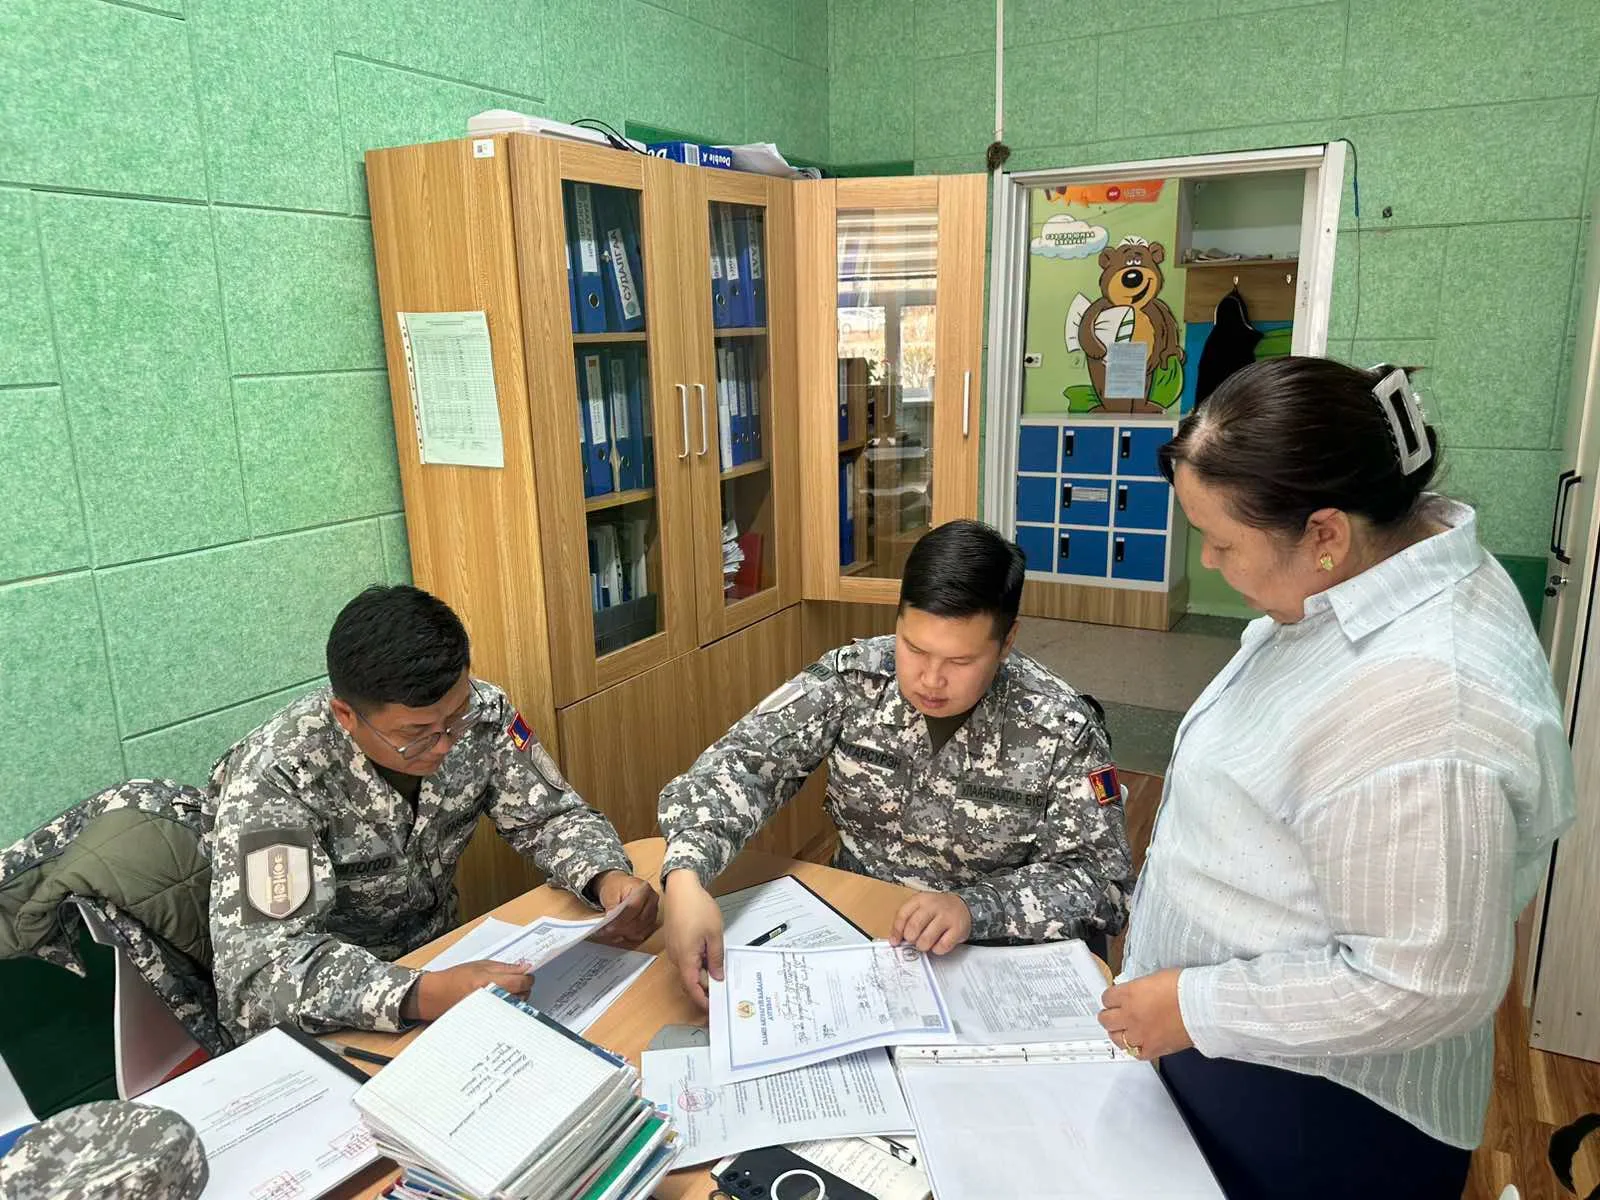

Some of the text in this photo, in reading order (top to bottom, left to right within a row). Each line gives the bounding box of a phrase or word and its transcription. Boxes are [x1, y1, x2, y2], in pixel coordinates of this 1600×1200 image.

[702, 152, 731, 168] Double A
[611, 231, 632, 301] СУДАЛГАА
